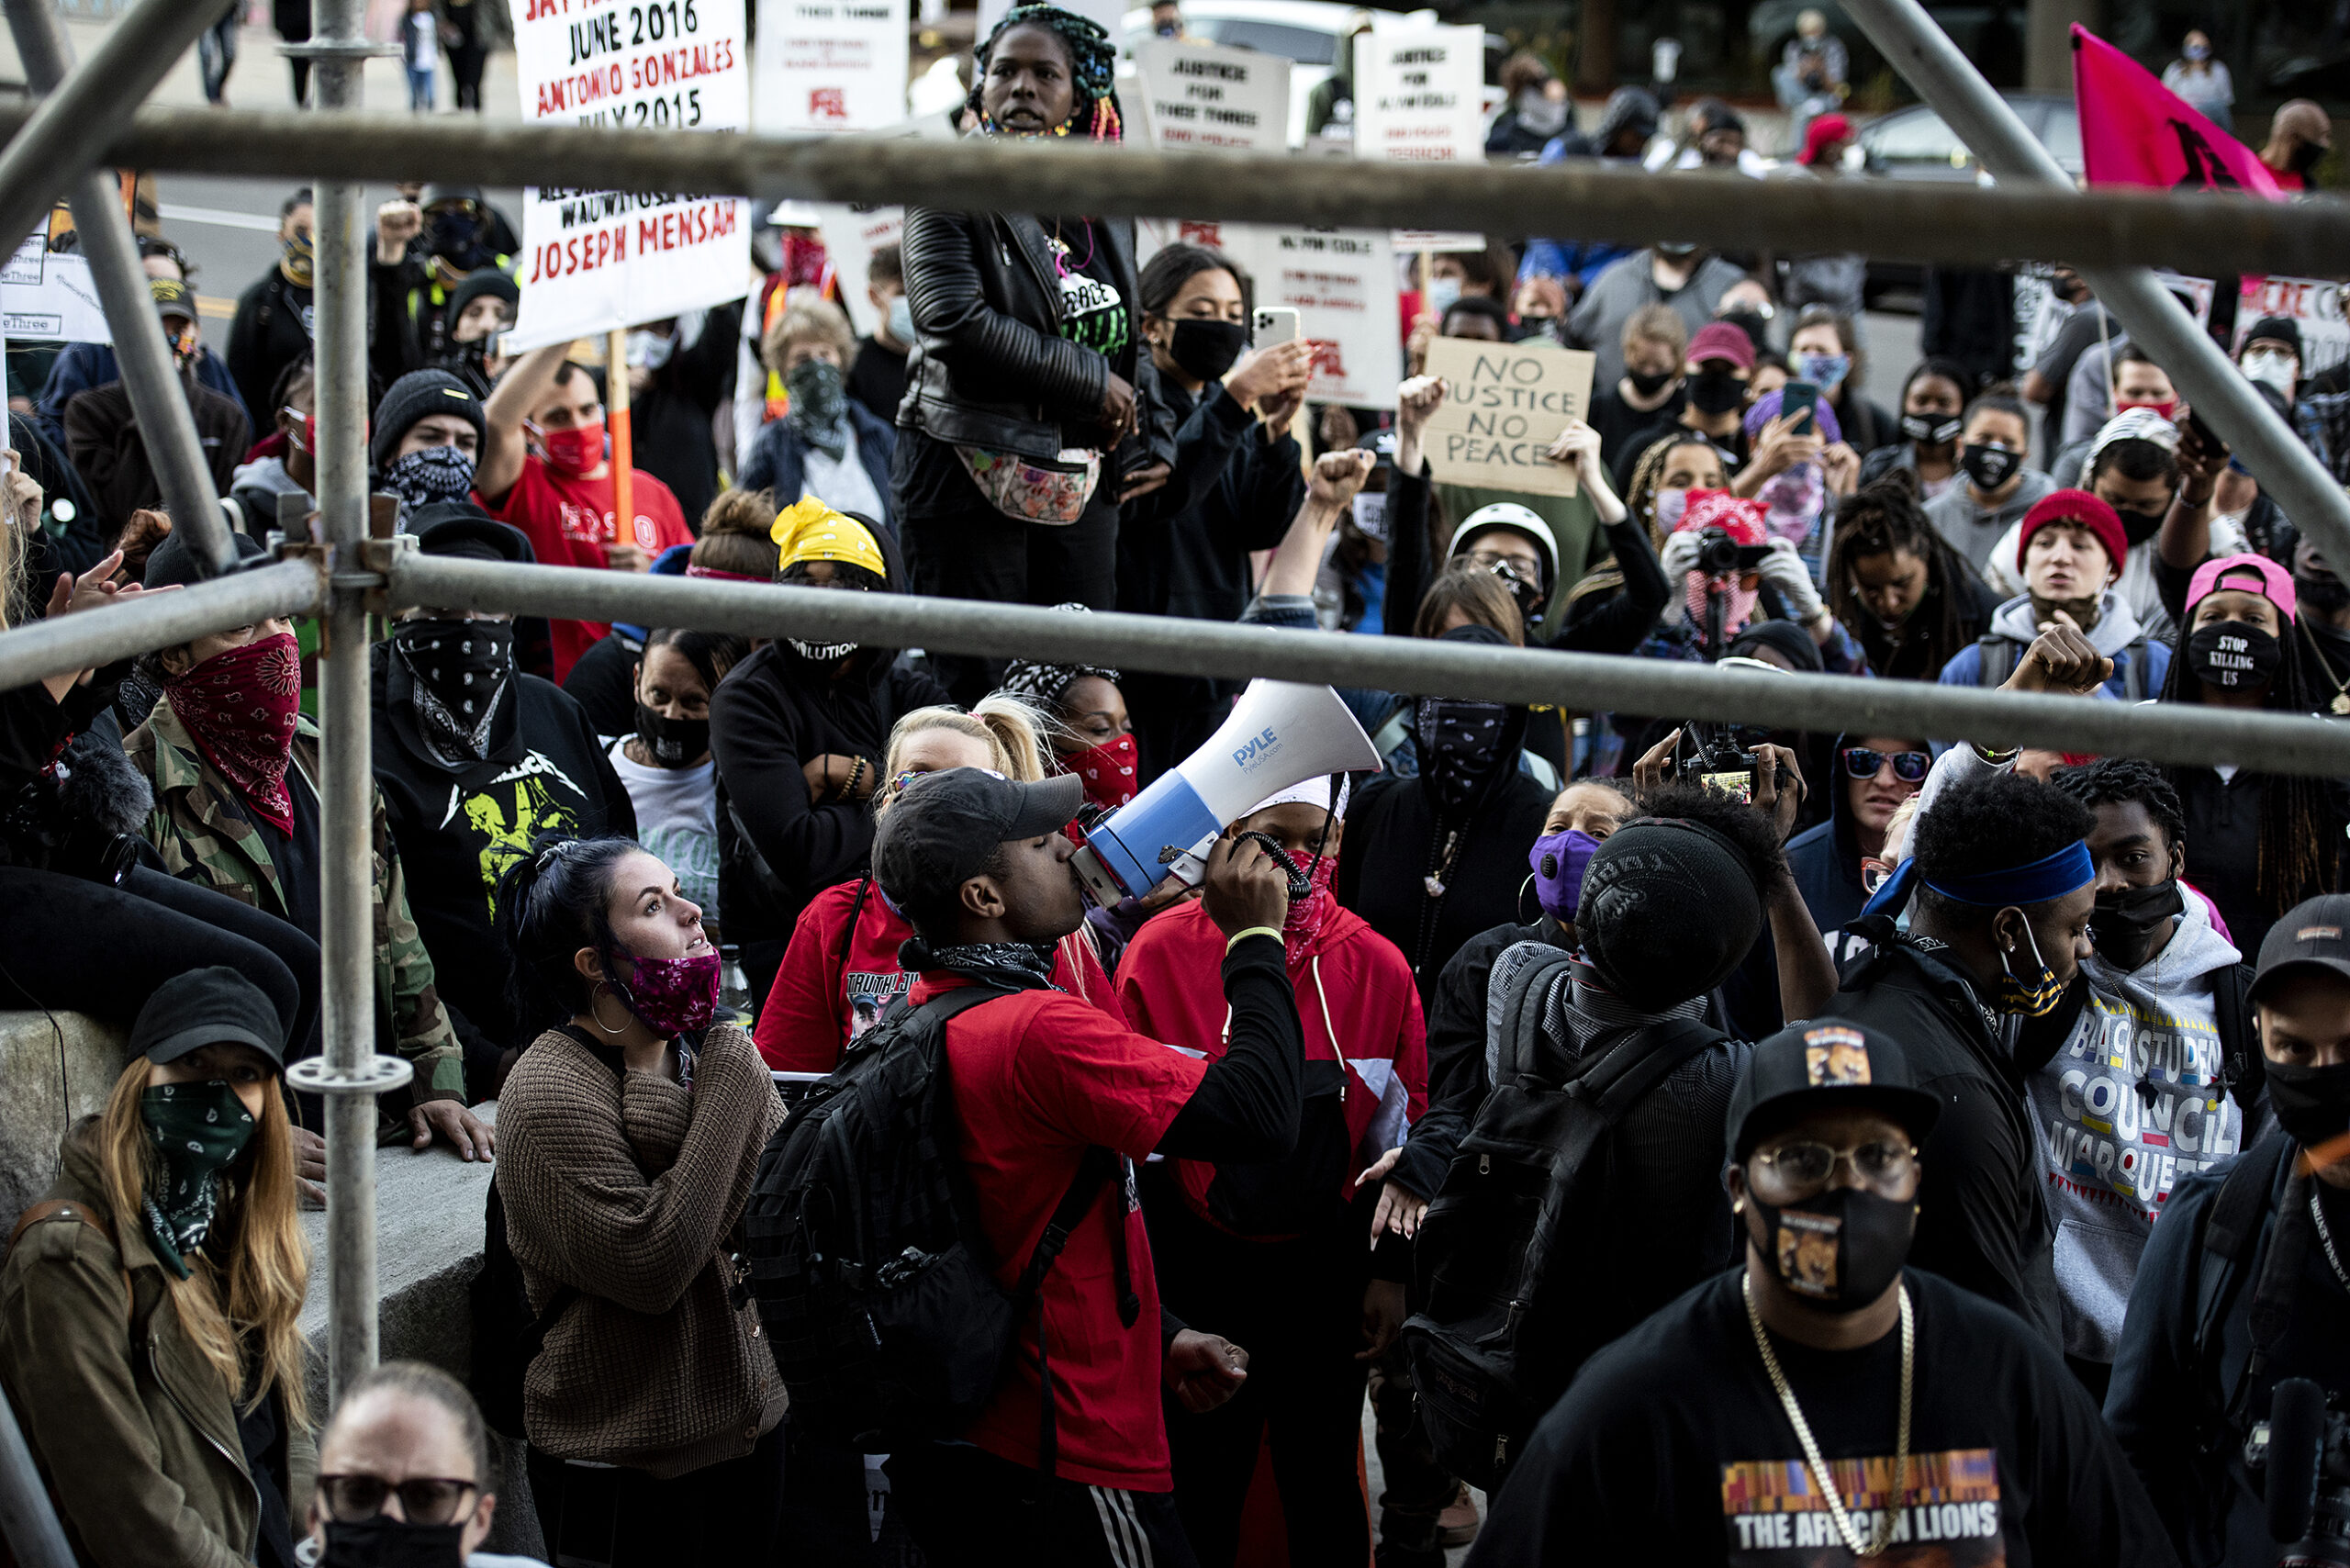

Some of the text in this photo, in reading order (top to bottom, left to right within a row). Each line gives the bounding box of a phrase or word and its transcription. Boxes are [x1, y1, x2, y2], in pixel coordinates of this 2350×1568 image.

[570, 0, 698, 66] JUNE 2016
[538, 62, 622, 118] ANTONIO
[632, 39, 733, 90] GONZALES
[634, 89, 700, 129] 2015
[531, 199, 737, 285] JOSEPH MENSAH
[1472, 353, 1544, 386] NO
[1467, 410, 1529, 449] NO
[1446, 434, 1559, 469] PEACE
[789, 642, 858, 660] OLUTION
[2209, 651, 2255, 670] KILLING
[2217, 634, 2249, 653] STOP
[2221, 670, 2239, 686] US
[846, 972, 900, 995] TRUTH!
[2133, 1029, 2222, 1087] STUDEN
[2050, 1121, 2215, 1202] MARQUE
[2310, 1193, 2330, 1240] SENTINEL
[2322, 1238, 2350, 1283] JOURNAL
[1734, 1501, 1998, 1550] THE AFCN LIONS
